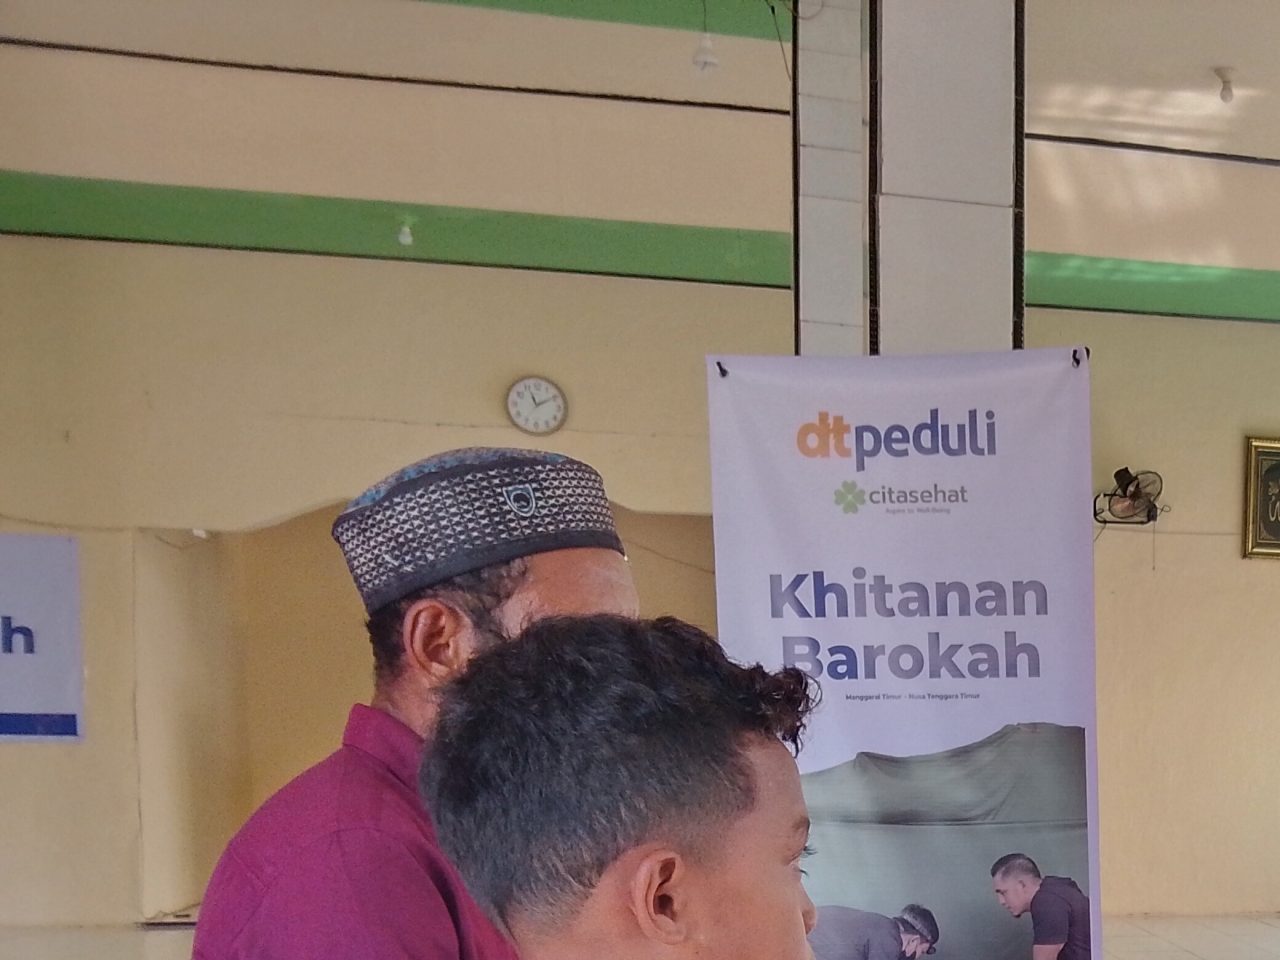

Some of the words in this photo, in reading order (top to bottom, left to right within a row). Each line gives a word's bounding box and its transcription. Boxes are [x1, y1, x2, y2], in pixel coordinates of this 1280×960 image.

[796, 406, 996, 472] dtpeduli
[868, 483, 969, 504] citasehat
[769, 567, 1049, 619] Khitanan
[782, 631, 1041, 681] Barokah
